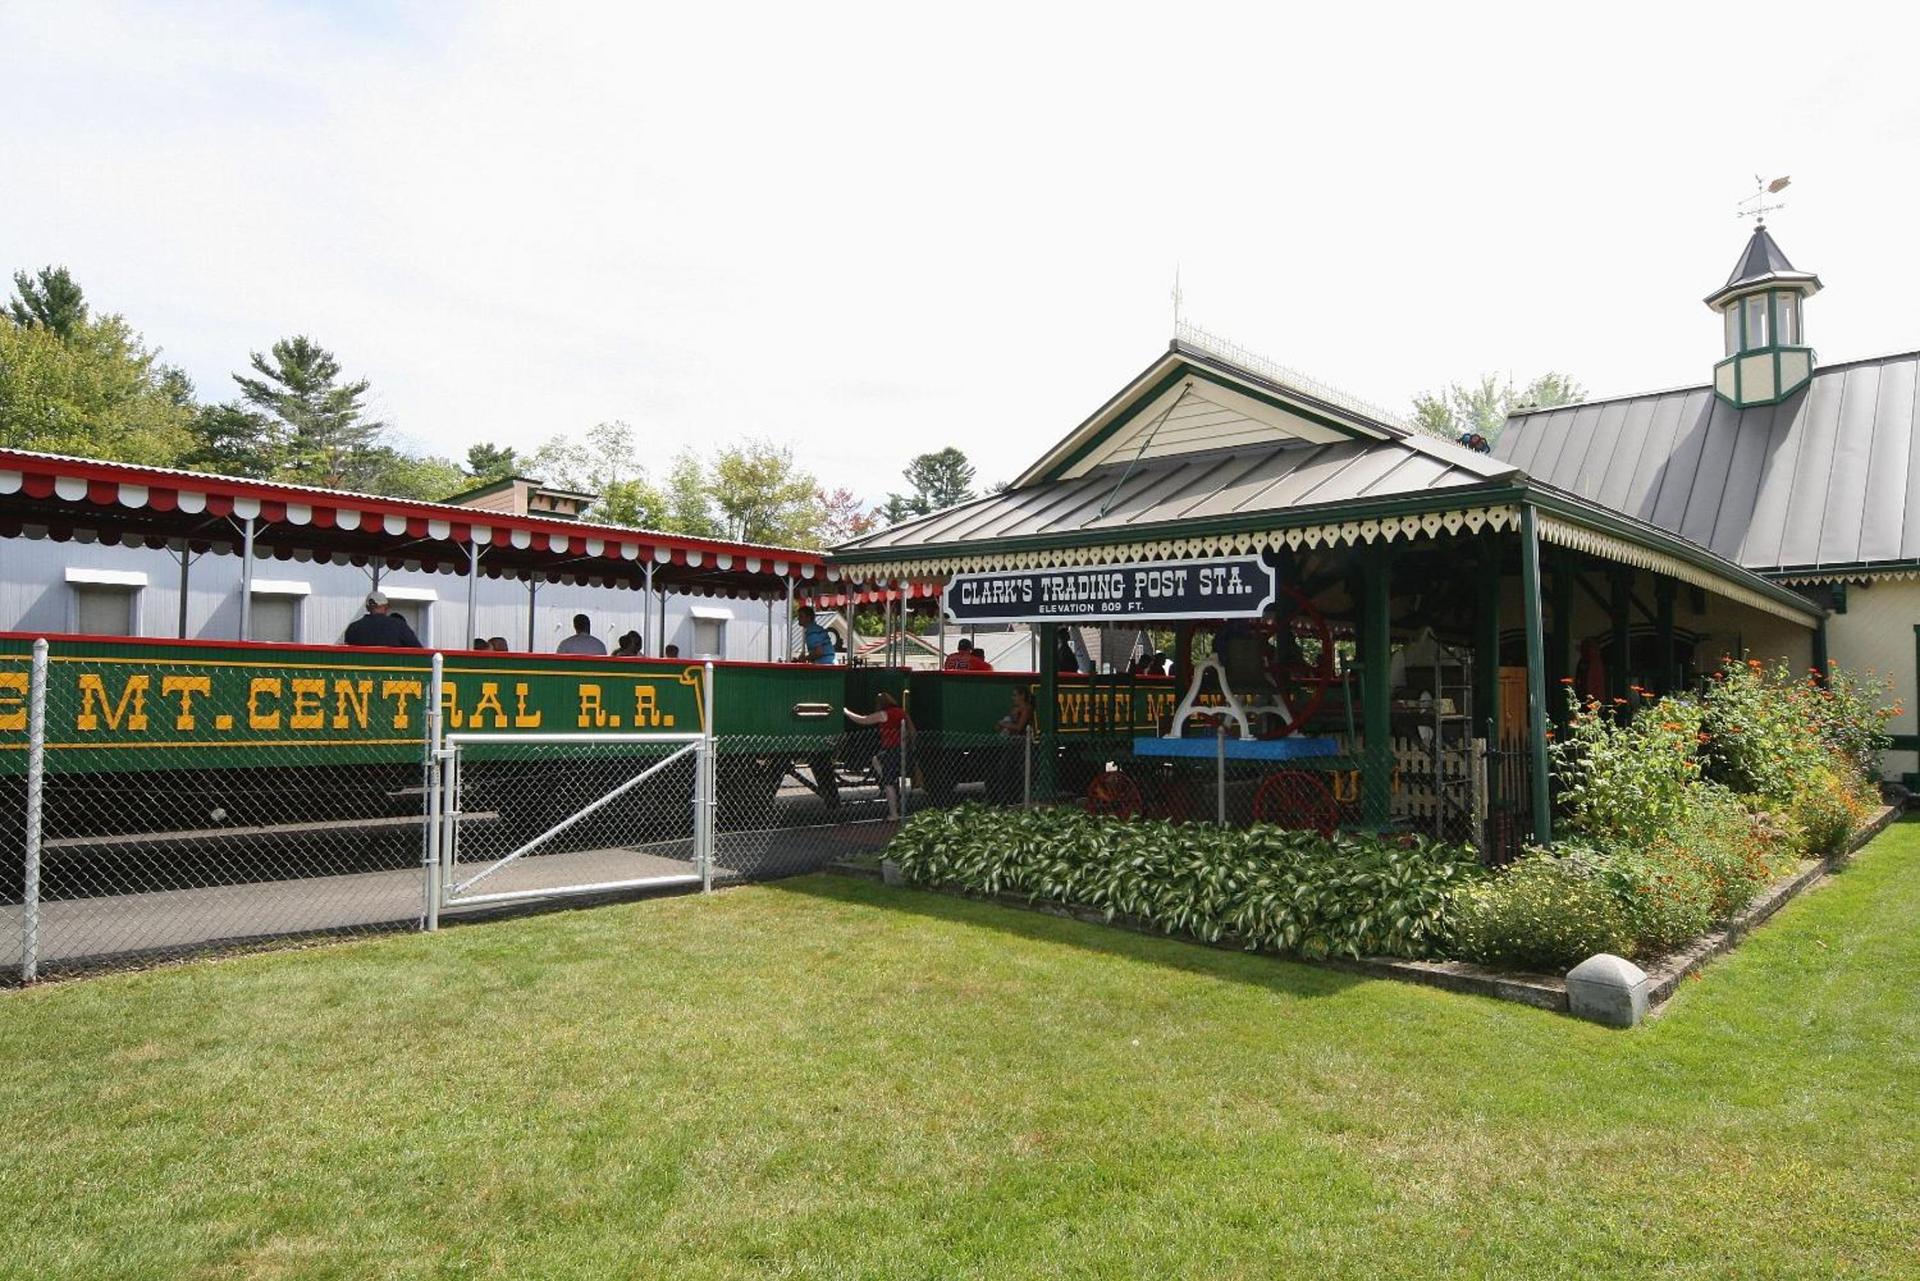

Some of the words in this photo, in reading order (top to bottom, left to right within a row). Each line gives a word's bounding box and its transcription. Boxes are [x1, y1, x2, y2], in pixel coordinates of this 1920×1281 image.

[961, 578, 1033, 605] CLARK'S
[1041, 572, 1126, 602] TRADING
[1134, 569, 1188, 599] POST
[1200, 566, 1252, 596] STA.
[1039, 603, 1095, 614] ELEVATION
[1128, 601, 1145, 612] FT.
